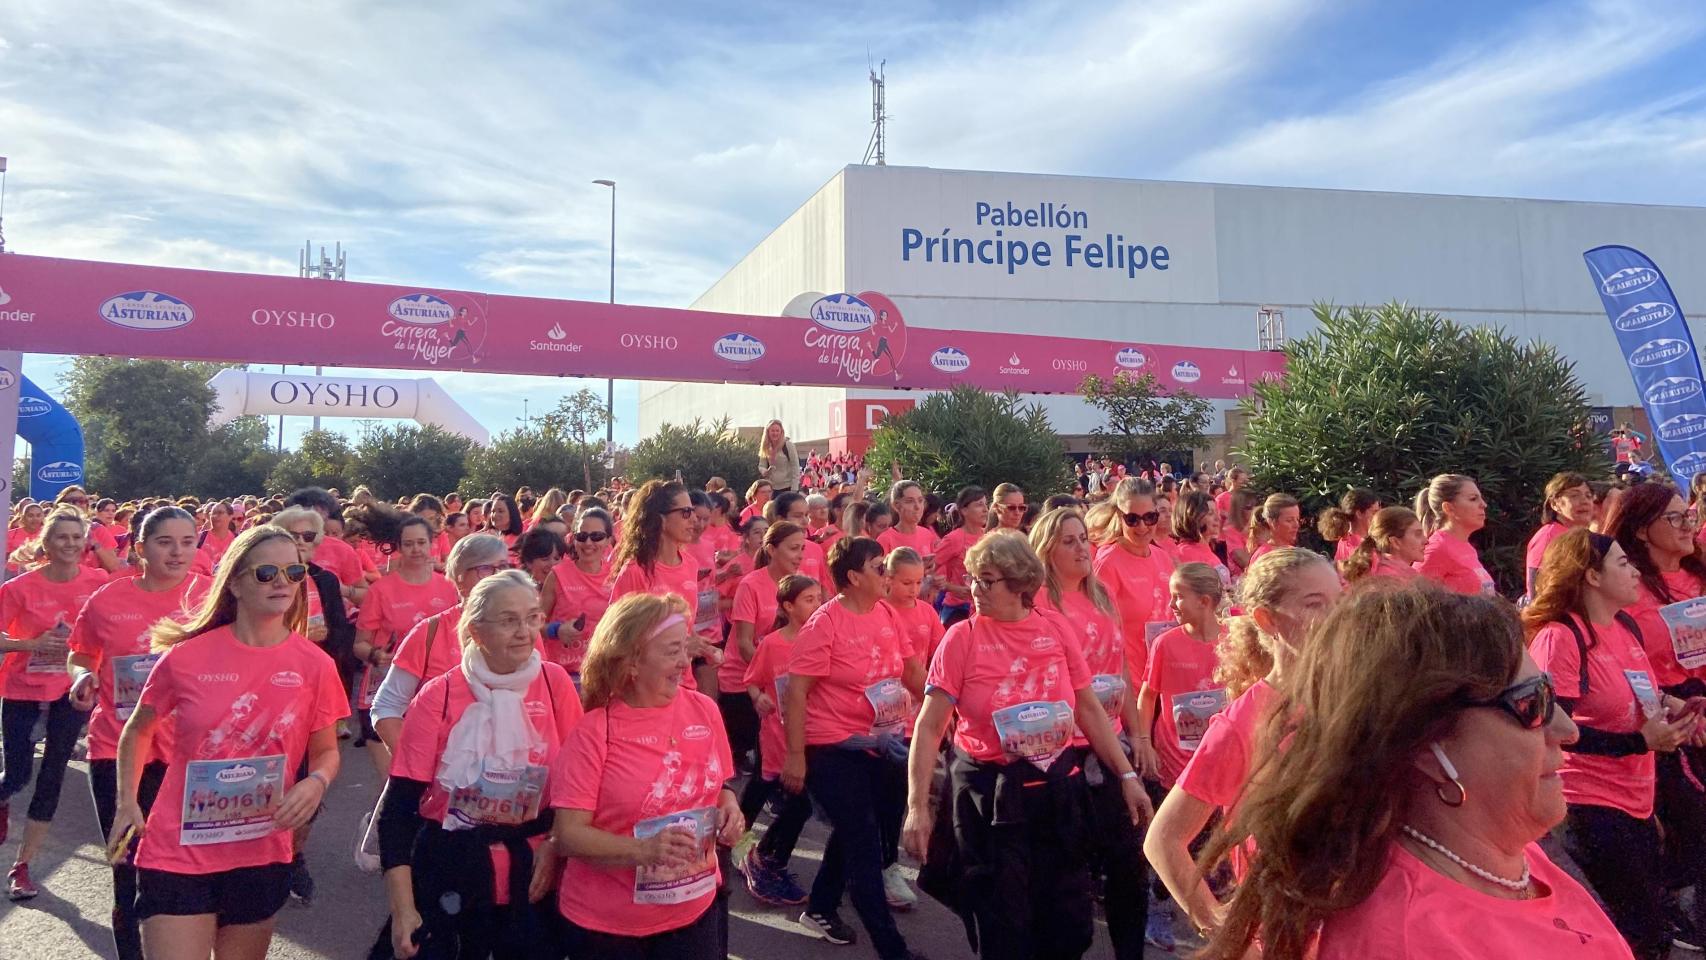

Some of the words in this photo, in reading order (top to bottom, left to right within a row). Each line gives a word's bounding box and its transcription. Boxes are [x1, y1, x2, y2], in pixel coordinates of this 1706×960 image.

[976, 201, 1088, 229] Pabellón
[902, 228, 1051, 275] Príncipe
[1065, 234, 1170, 278] Felipe
[0, 309, 36, 322] nder
[107, 303, 187, 321] ASTURIANA
[252, 309, 335, 329] OYSHO
[394, 304, 450, 318] ASTURIANA
[816, 305, 871, 324] ASTURIANA
[381, 321, 438, 340] Carrera
[804, 327, 860, 350] Carrera
[412, 338, 456, 364] Mujer
[530, 340, 583, 352] Santander
[620, 333, 678, 350] OYSHO
[717, 343, 762, 356] ASTURIANA
[818, 350, 829, 364] de
[836, 349, 880, 382] Mujer
[1052, 358, 1087, 371] OYSHO
[270, 380, 399, 409] OYSHO
[865, 404, 890, 430] D
[198, 673, 239, 682] OYSHO
